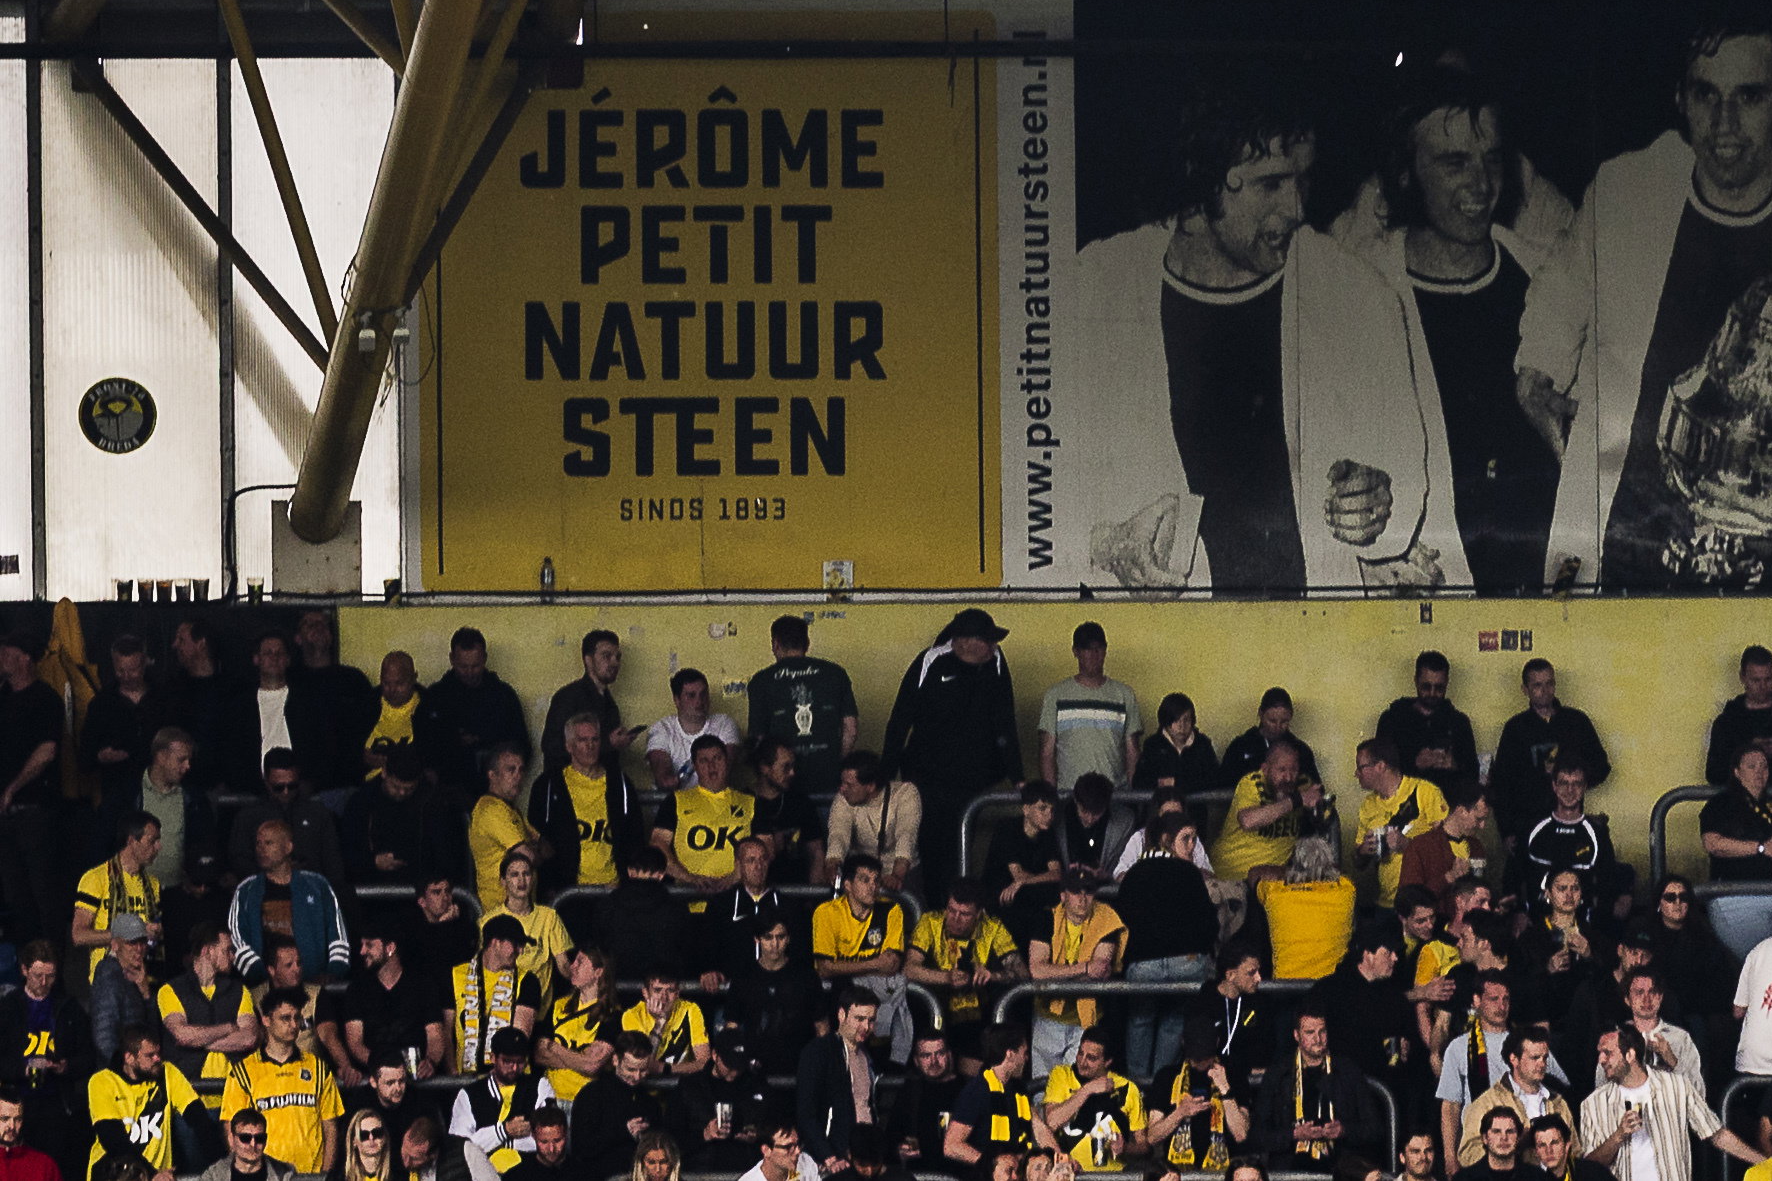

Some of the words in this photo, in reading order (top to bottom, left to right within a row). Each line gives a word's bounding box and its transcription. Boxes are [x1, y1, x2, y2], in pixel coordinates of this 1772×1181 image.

[519, 85, 885, 190] JÉRÔME
[579, 204, 834, 285] PETIT
[524, 300, 888, 381] NATUUR
[562, 396, 846, 478] STEEN
[687, 825, 745, 851] OK
